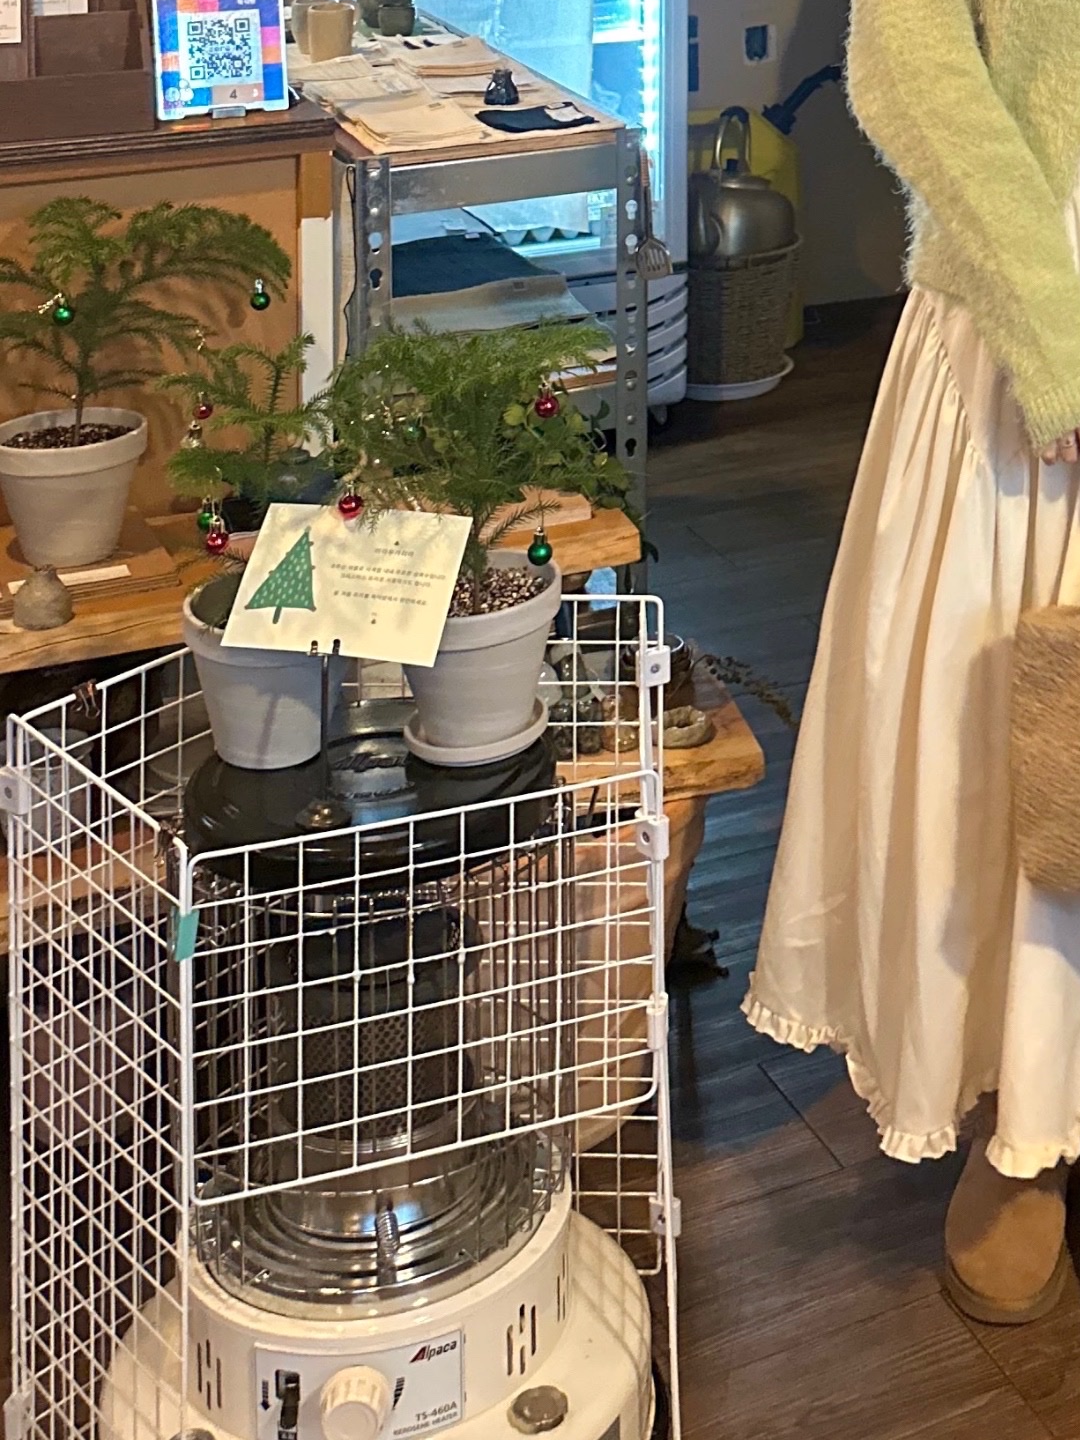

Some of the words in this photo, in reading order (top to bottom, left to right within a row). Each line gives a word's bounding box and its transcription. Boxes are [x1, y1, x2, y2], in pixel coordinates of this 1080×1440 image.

[409, 1340, 457, 1363] Alpaca
[415, 1401, 457, 1421] TS-460A
[431, 1411, 458, 1425] HEATER
